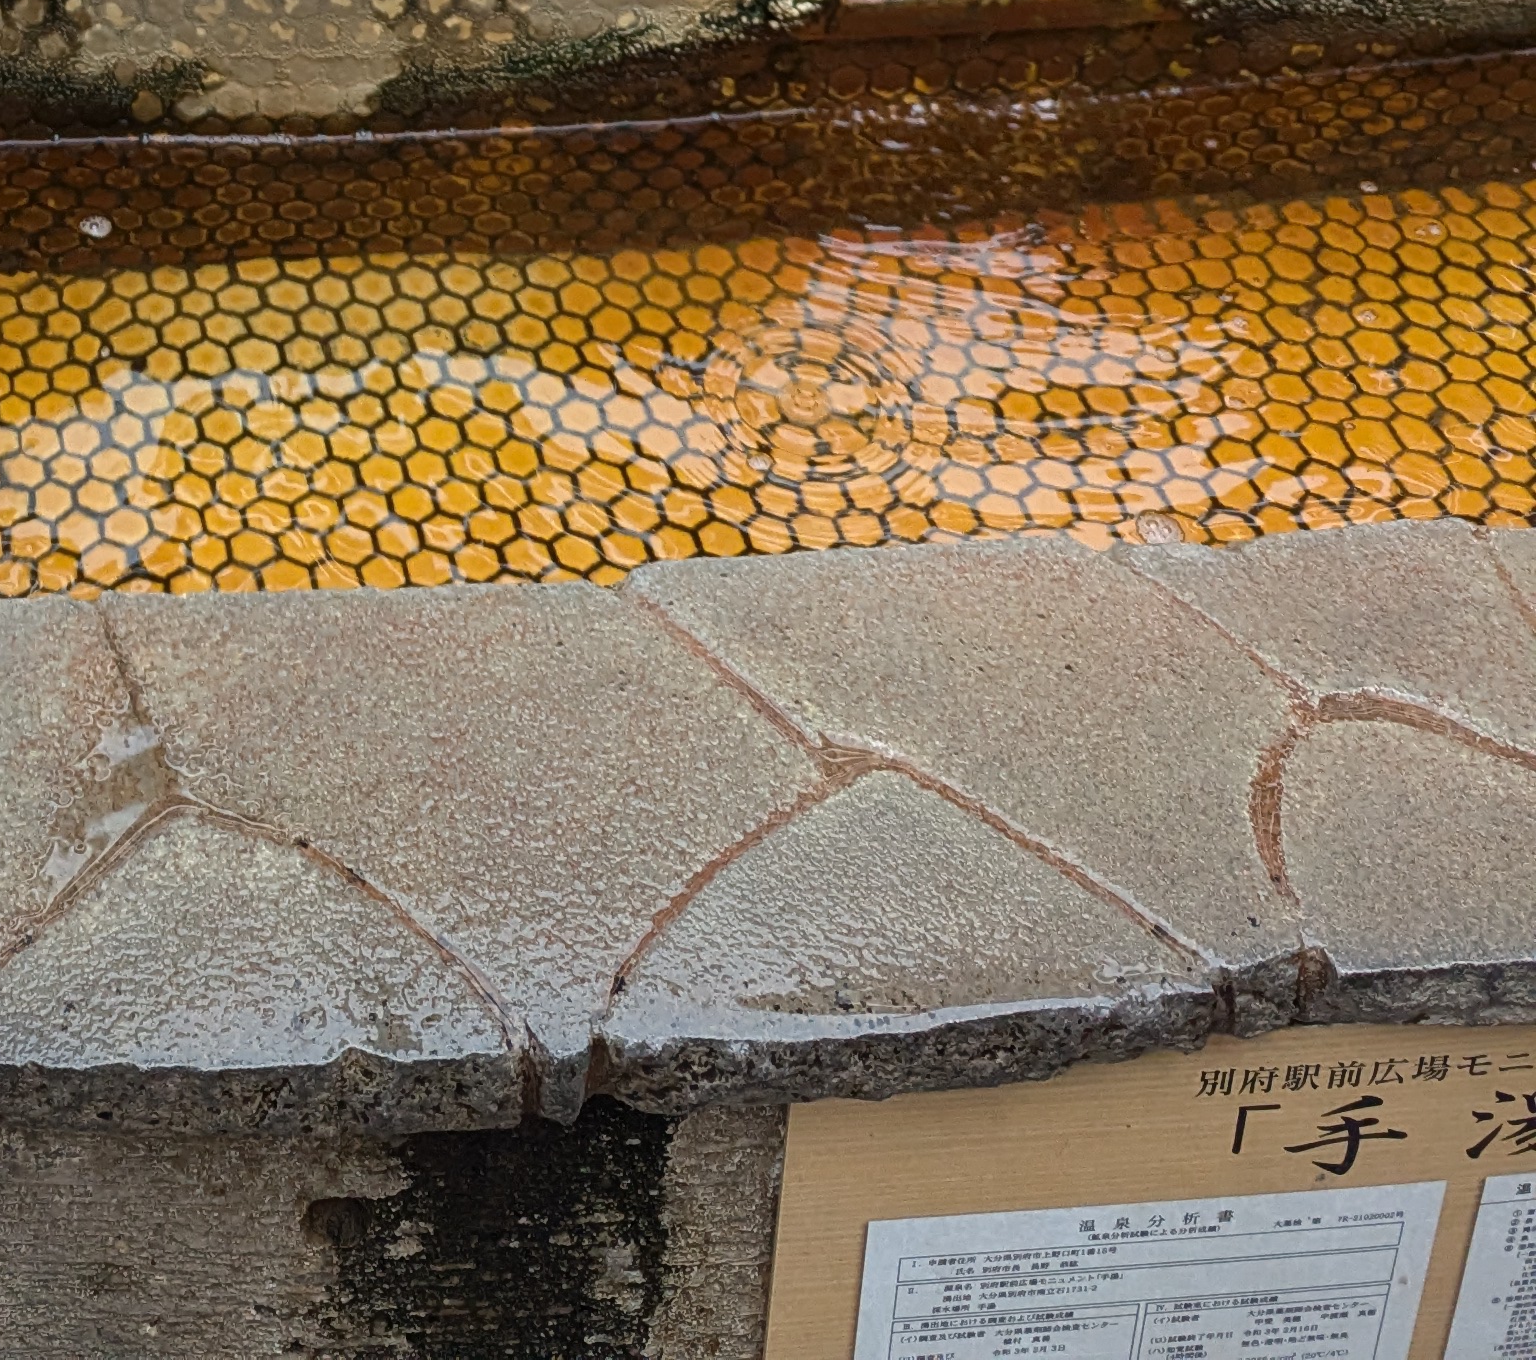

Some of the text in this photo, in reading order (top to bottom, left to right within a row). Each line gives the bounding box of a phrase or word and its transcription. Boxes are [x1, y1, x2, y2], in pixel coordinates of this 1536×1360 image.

[1195, 1053, 1534, 1097] 別府駅前広場モニ
[1079, 1210, 1234, 1233] 温泉分析書
